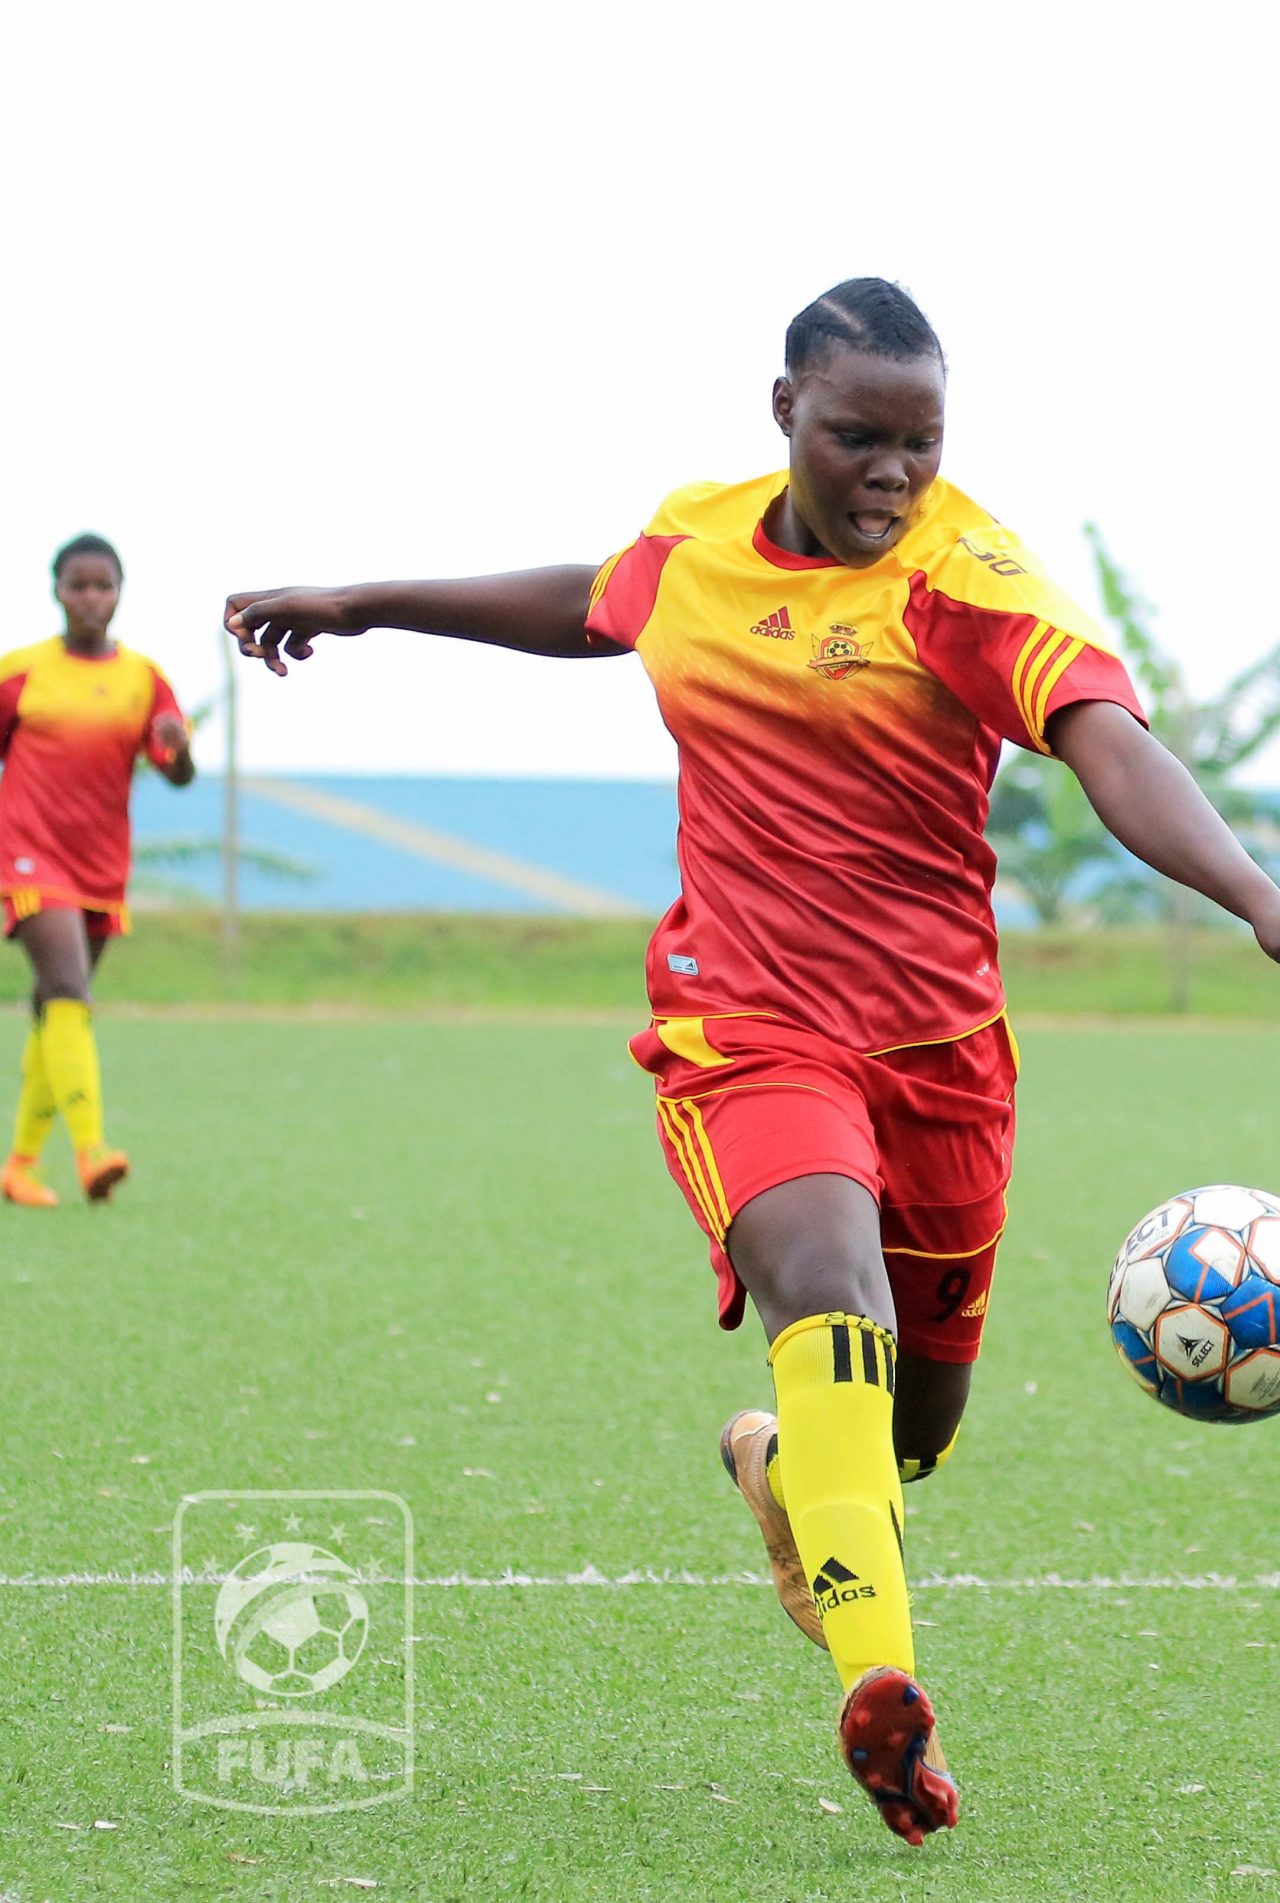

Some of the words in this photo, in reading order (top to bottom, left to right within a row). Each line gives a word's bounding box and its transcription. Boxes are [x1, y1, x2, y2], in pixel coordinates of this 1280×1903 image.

[749, 625, 796, 640] adidas
[931, 1267, 972, 1323] 9
[1191, 1339, 1215, 1368] SELECT
